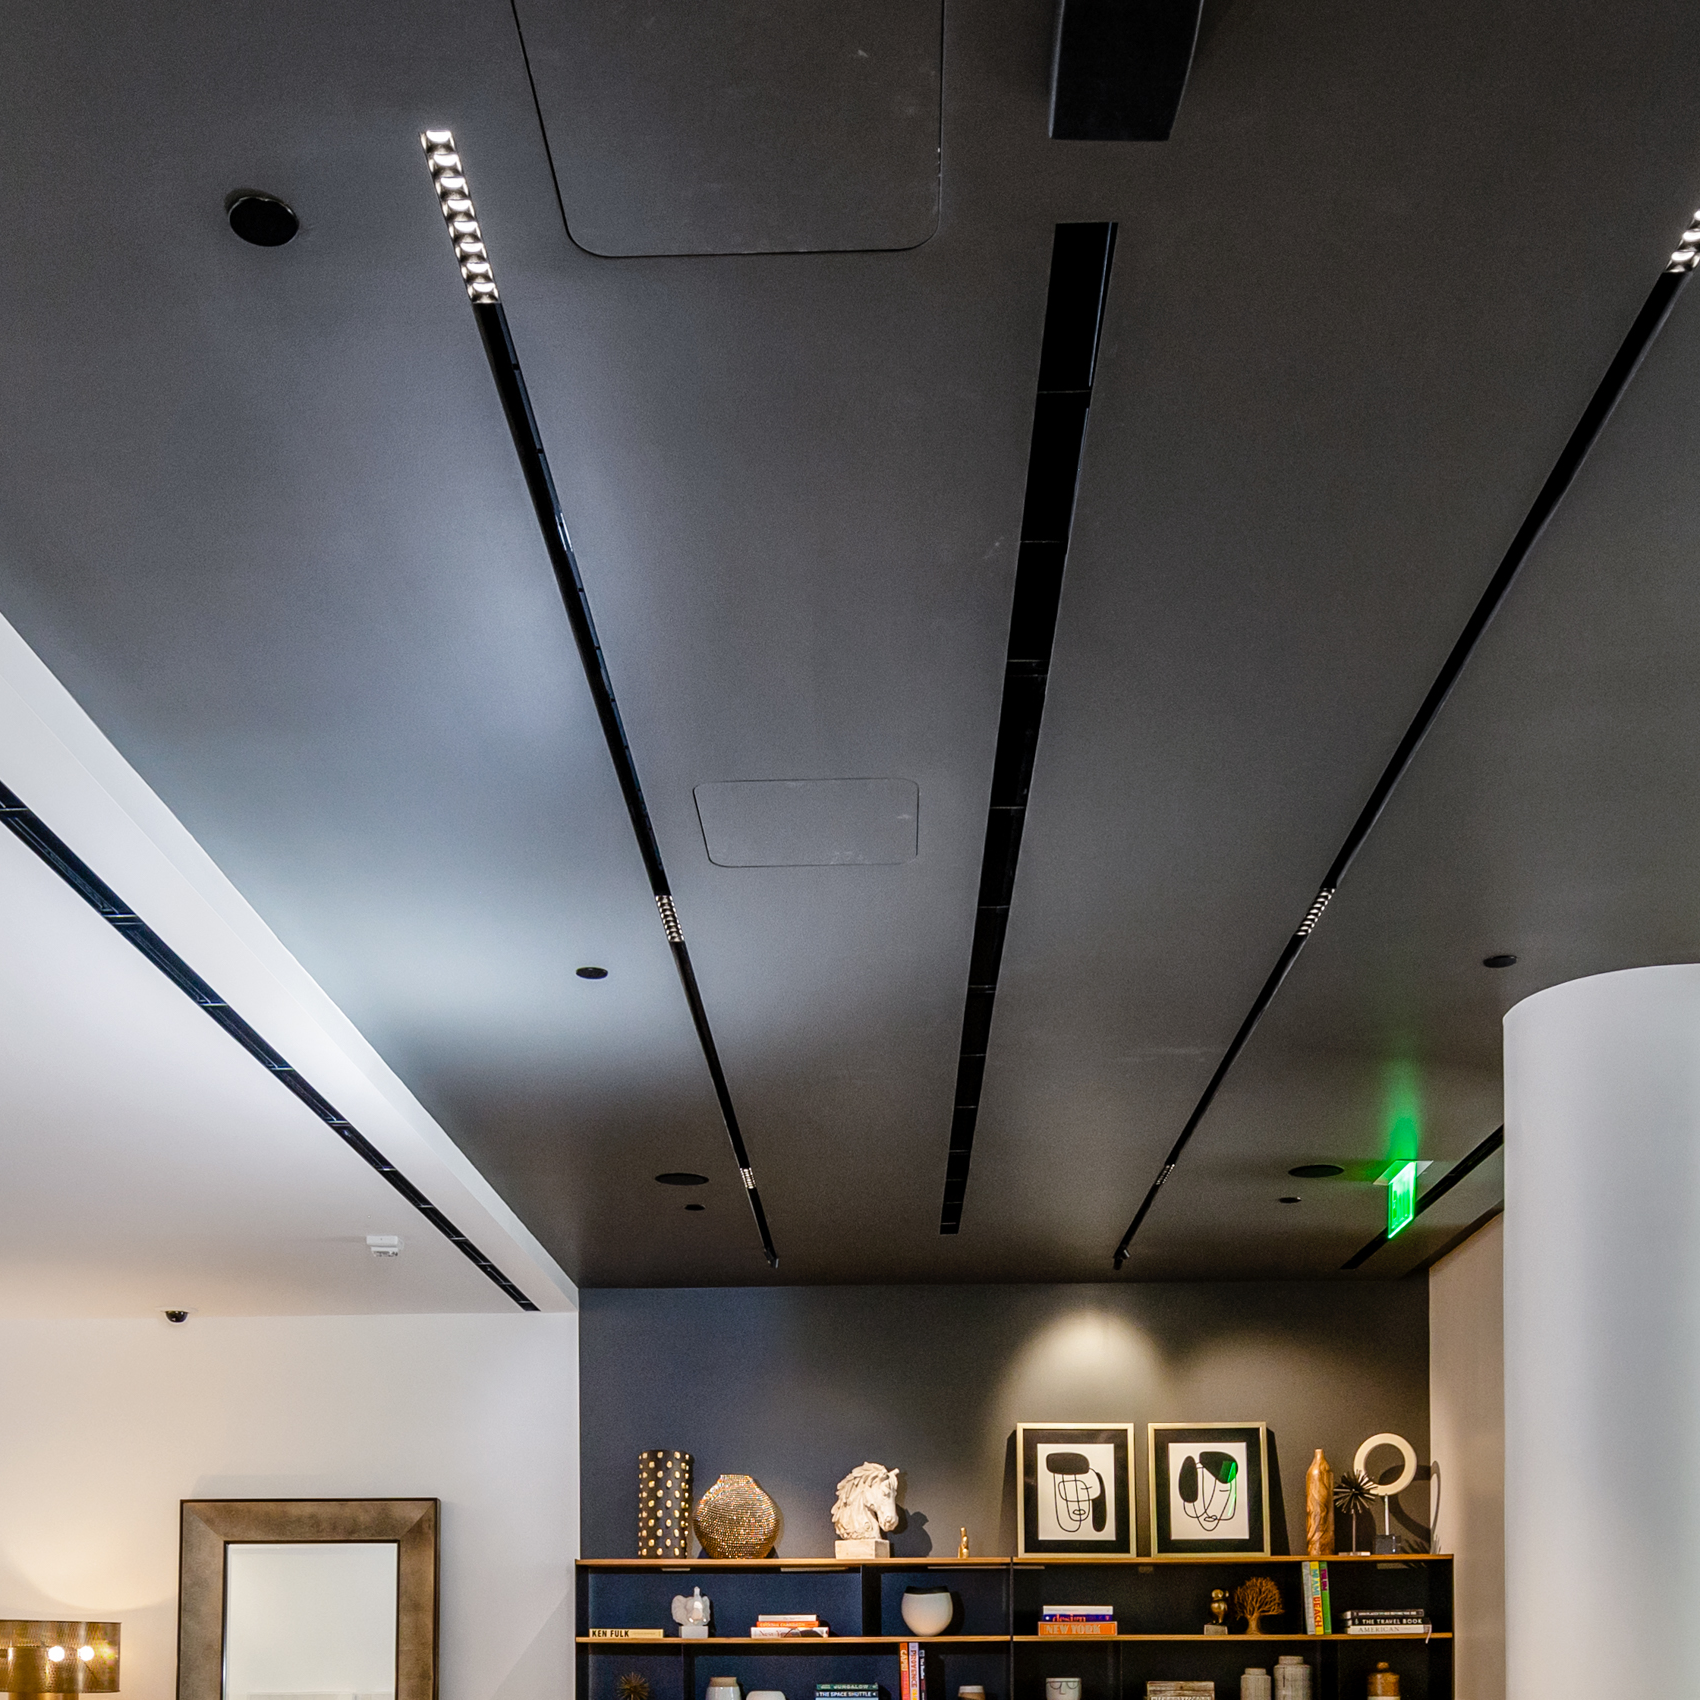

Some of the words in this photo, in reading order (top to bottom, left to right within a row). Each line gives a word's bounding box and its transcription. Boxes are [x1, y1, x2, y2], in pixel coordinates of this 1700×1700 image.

[1312, 1568, 1320, 1595] MIAMI
[1313, 1596, 1322, 1627] BEACH
[591, 1629, 608, 1638] KEN
[610, 1629, 630, 1638] FULK
[1046, 1625, 1069, 1634] NEW
[1071, 1625, 1101, 1634] YORK
[900, 1649, 908, 1671] CAPRI
[910, 1649, 918, 1688] PROVENCE
